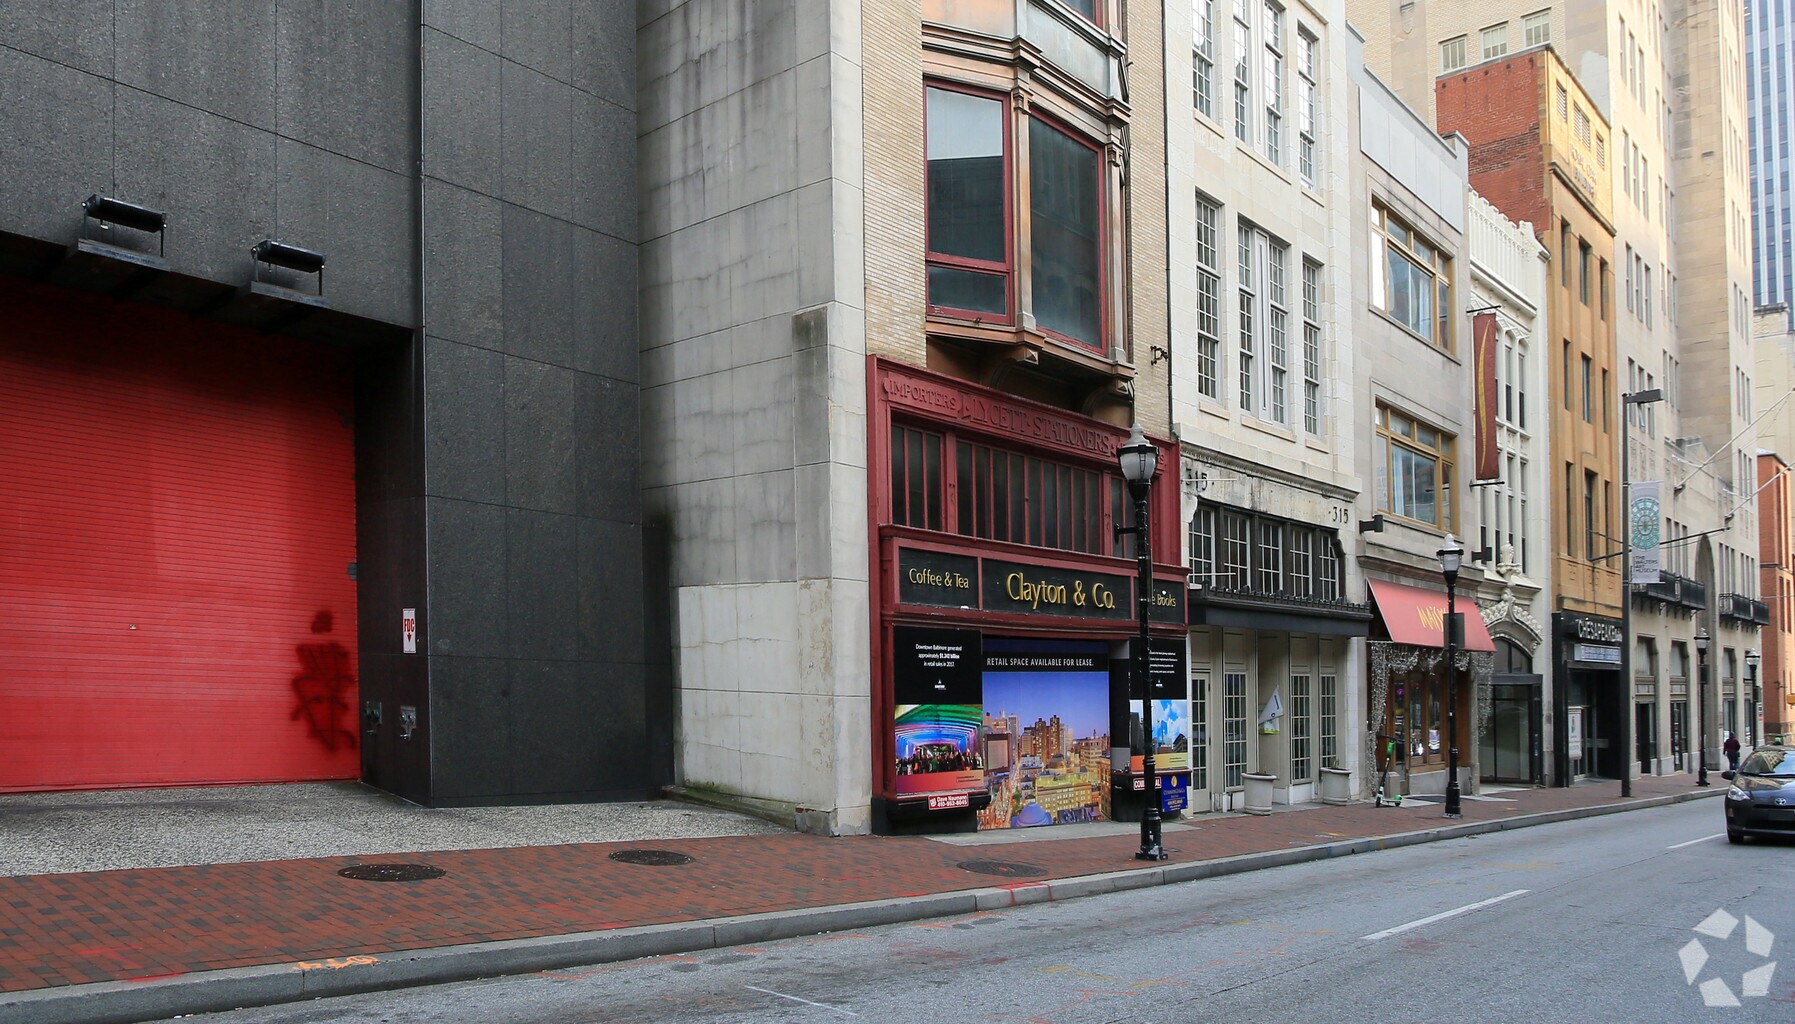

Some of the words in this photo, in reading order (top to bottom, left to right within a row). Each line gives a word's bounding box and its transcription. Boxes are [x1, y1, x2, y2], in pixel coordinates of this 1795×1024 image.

[1332, 506, 1349, 524] 315
[909, 568, 942, 586] Coffee
[944, 572, 952, 587] &
[954, 573, 969, 588] Tea
[1006, 572, 1067, 610] Clayton
[1073, 580, 1086, 606] &
[1092, 582, 1116, 609] Co.
[1157, 593, 1176, 607] Books
[404, 618, 415, 632] FDC
[986, 657, 1009, 666] RETAIL
[1010, 657, 1029, 666] SPACE
[1030, 658, 1062, 666] AVAILABLE
[1063, 658, 1075, 667] FOR
[1076, 658, 1094, 667] LEASE.
